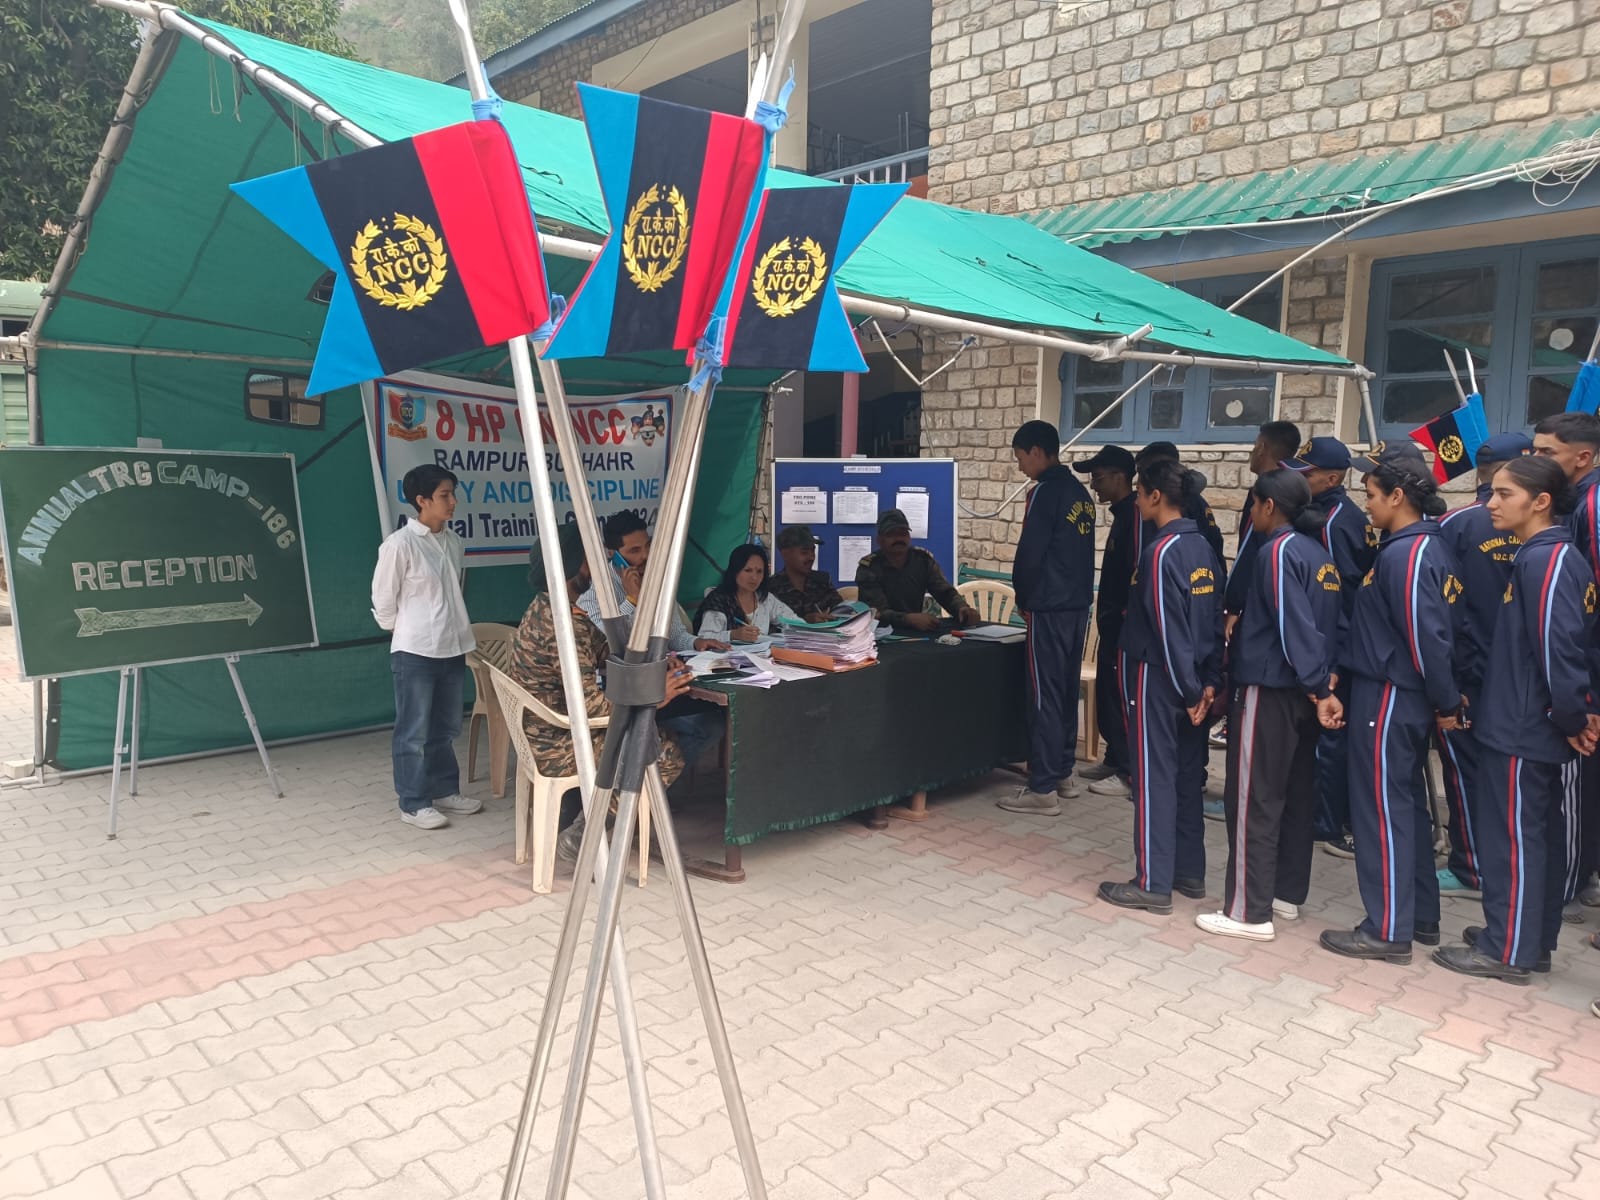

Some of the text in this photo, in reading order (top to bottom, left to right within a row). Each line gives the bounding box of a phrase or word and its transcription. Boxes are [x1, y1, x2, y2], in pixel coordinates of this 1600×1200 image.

[636, 234, 676, 258] NCC
[372, 252, 430, 286] NCC
[765, 273, 810, 291] NCC
[435, 399, 456, 442] 8
[463, 402, 506, 443] HP
[569, 408, 627, 446] NCC
[434, 448, 635, 473] RAMPUR BUHAHR
[482, 481, 532, 504] AND
[17, 479, 98, 567] ANNUAL
[88, 461, 152, 494] TRG
[72, 554, 258, 591] RECEPTION
